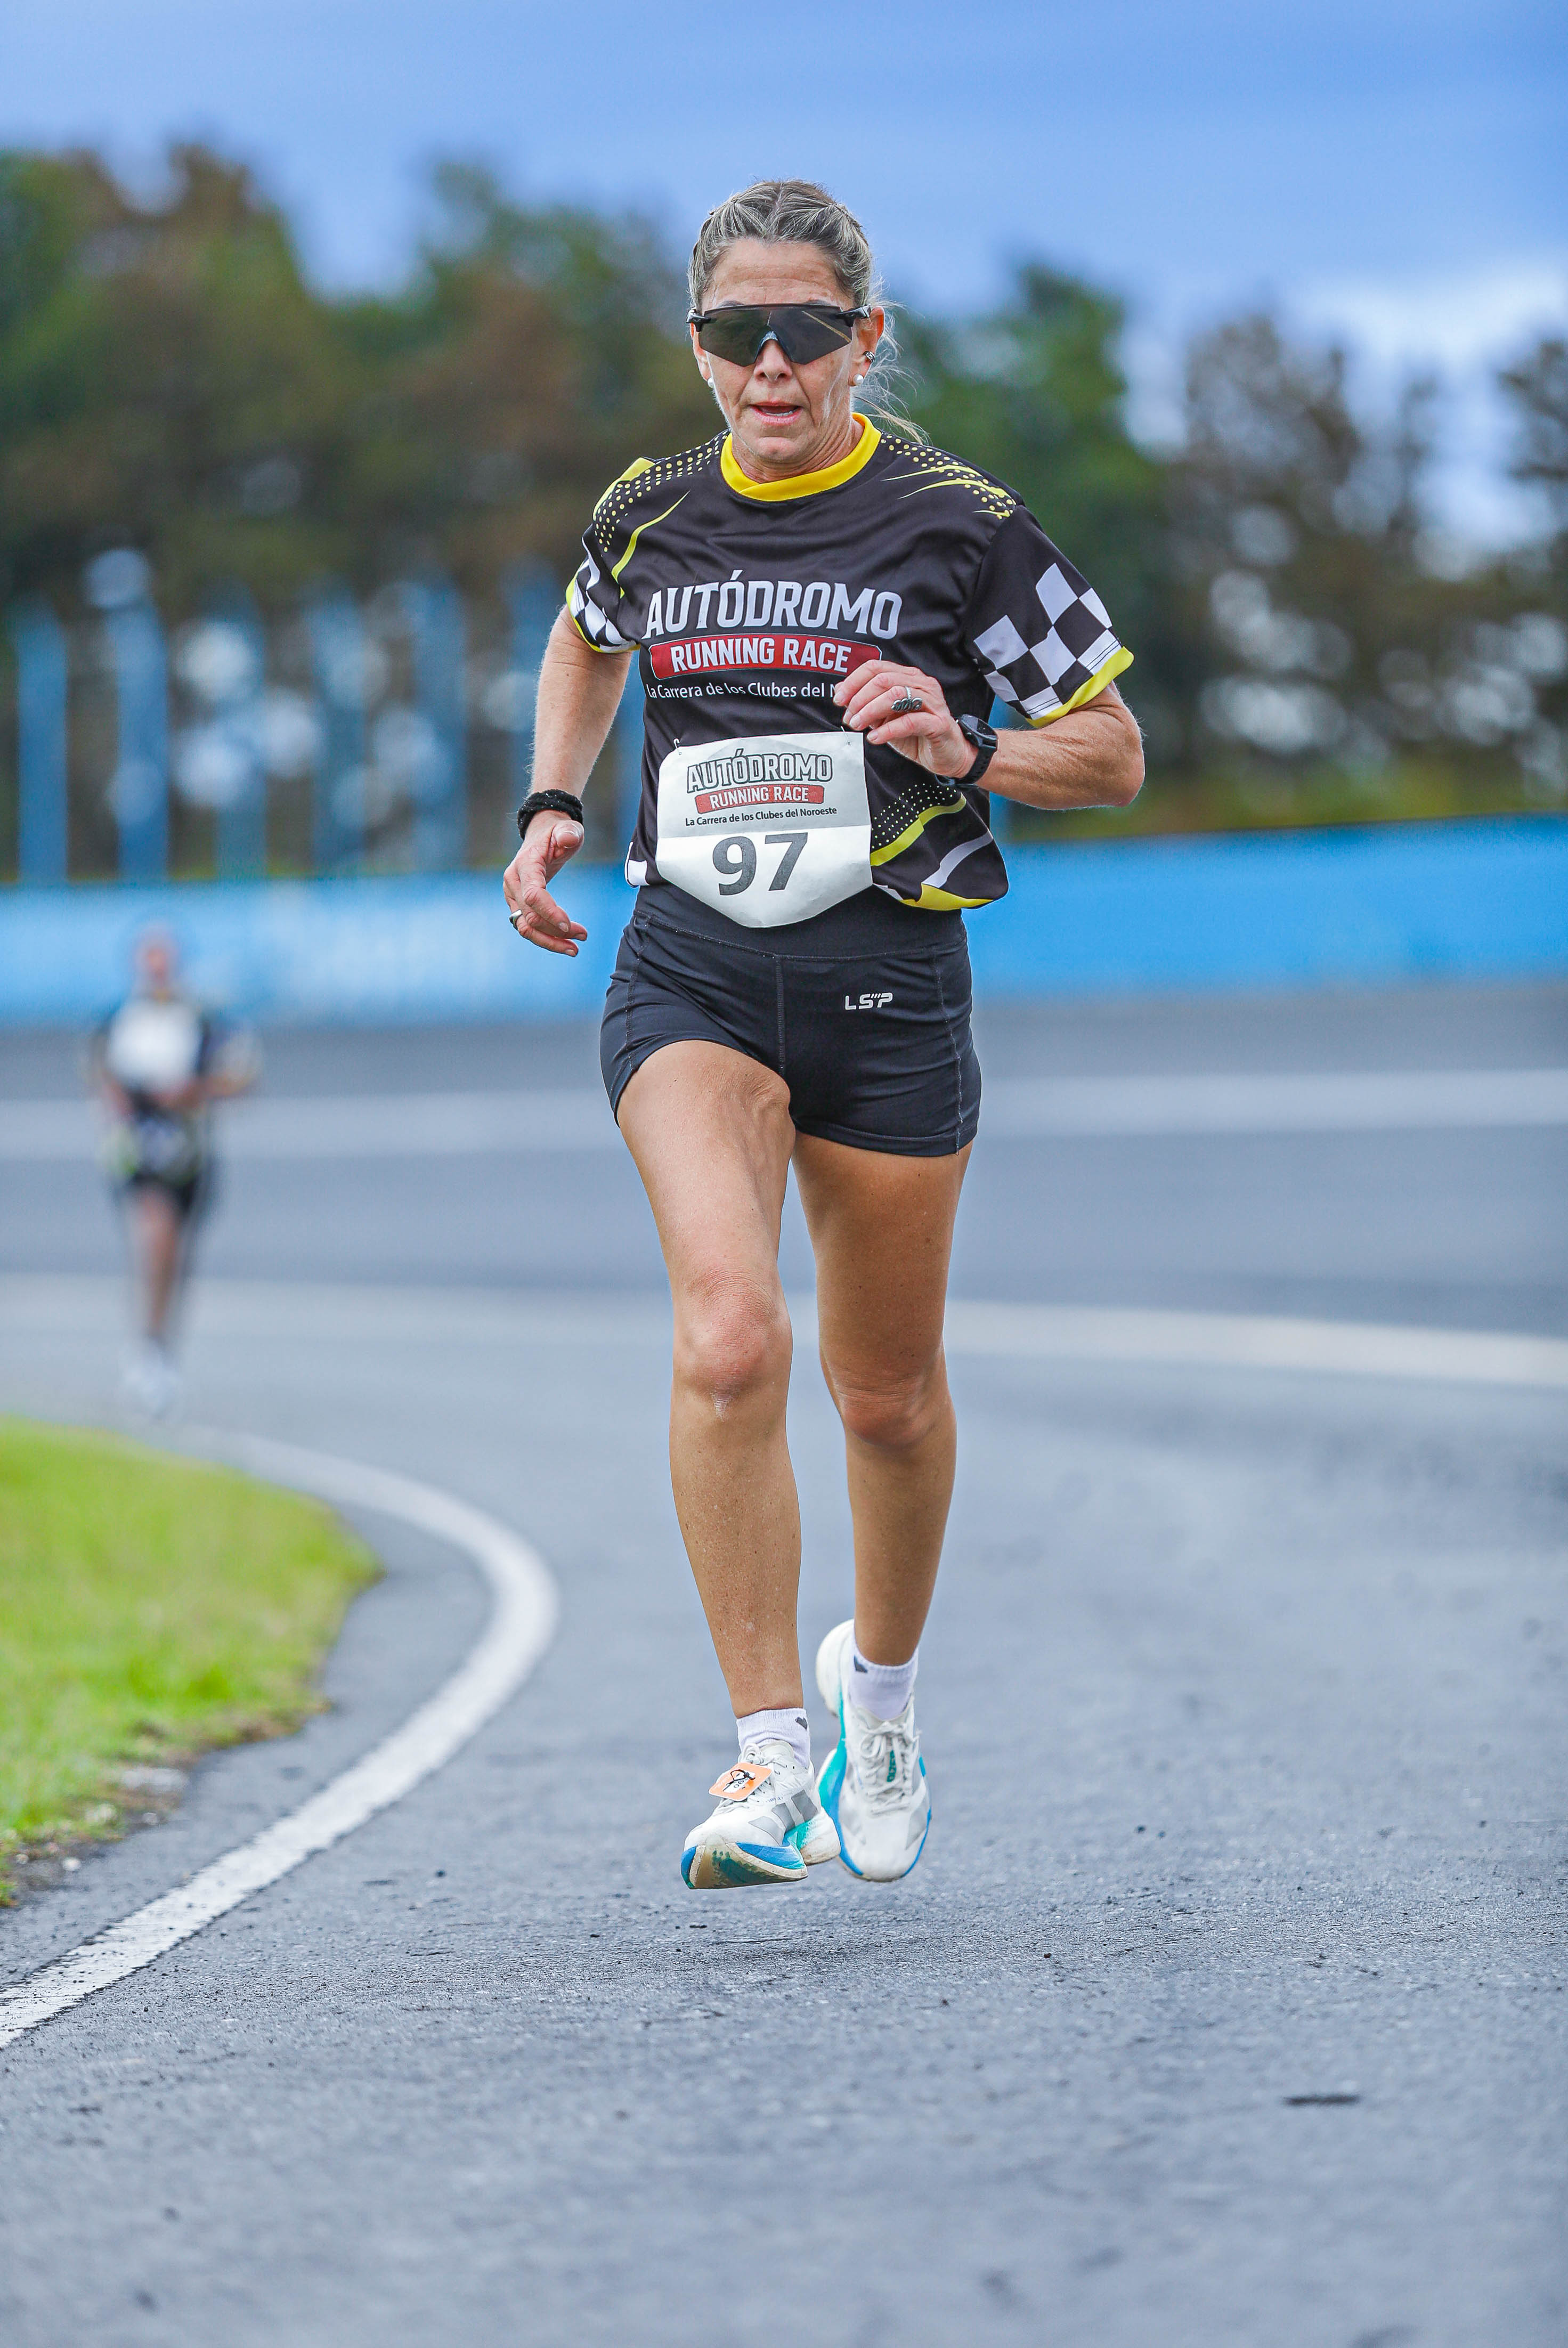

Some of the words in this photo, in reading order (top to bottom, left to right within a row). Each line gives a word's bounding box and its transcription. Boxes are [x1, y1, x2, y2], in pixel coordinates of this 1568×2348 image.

[641, 570, 903, 639] AUTÓDROMO
[670, 637, 775, 673] RUNNING
[783, 640, 852, 673] RACE
[657, 684, 703, 698] Carrera
[705, 682, 724, 695] de
[724, 683, 746, 694] los
[748, 682, 798, 697] Clubes
[801, 683, 825, 697] del
[687, 748, 833, 793] AUTÓDROMO
[709, 786, 769, 809] RUNNING
[774, 786, 809, 802] RACE
[686, 818, 695, 826] La
[696, 815, 727, 825] Carrera
[729, 814, 740, 822] de
[742, 813, 754, 821] los
[755, 811, 783, 820] Clubes
[786, 809, 798, 818] del
[800, 807, 837, 817] Noroeste
[713, 832, 808, 896] 97
[845, 993, 893, 1010] LSP
